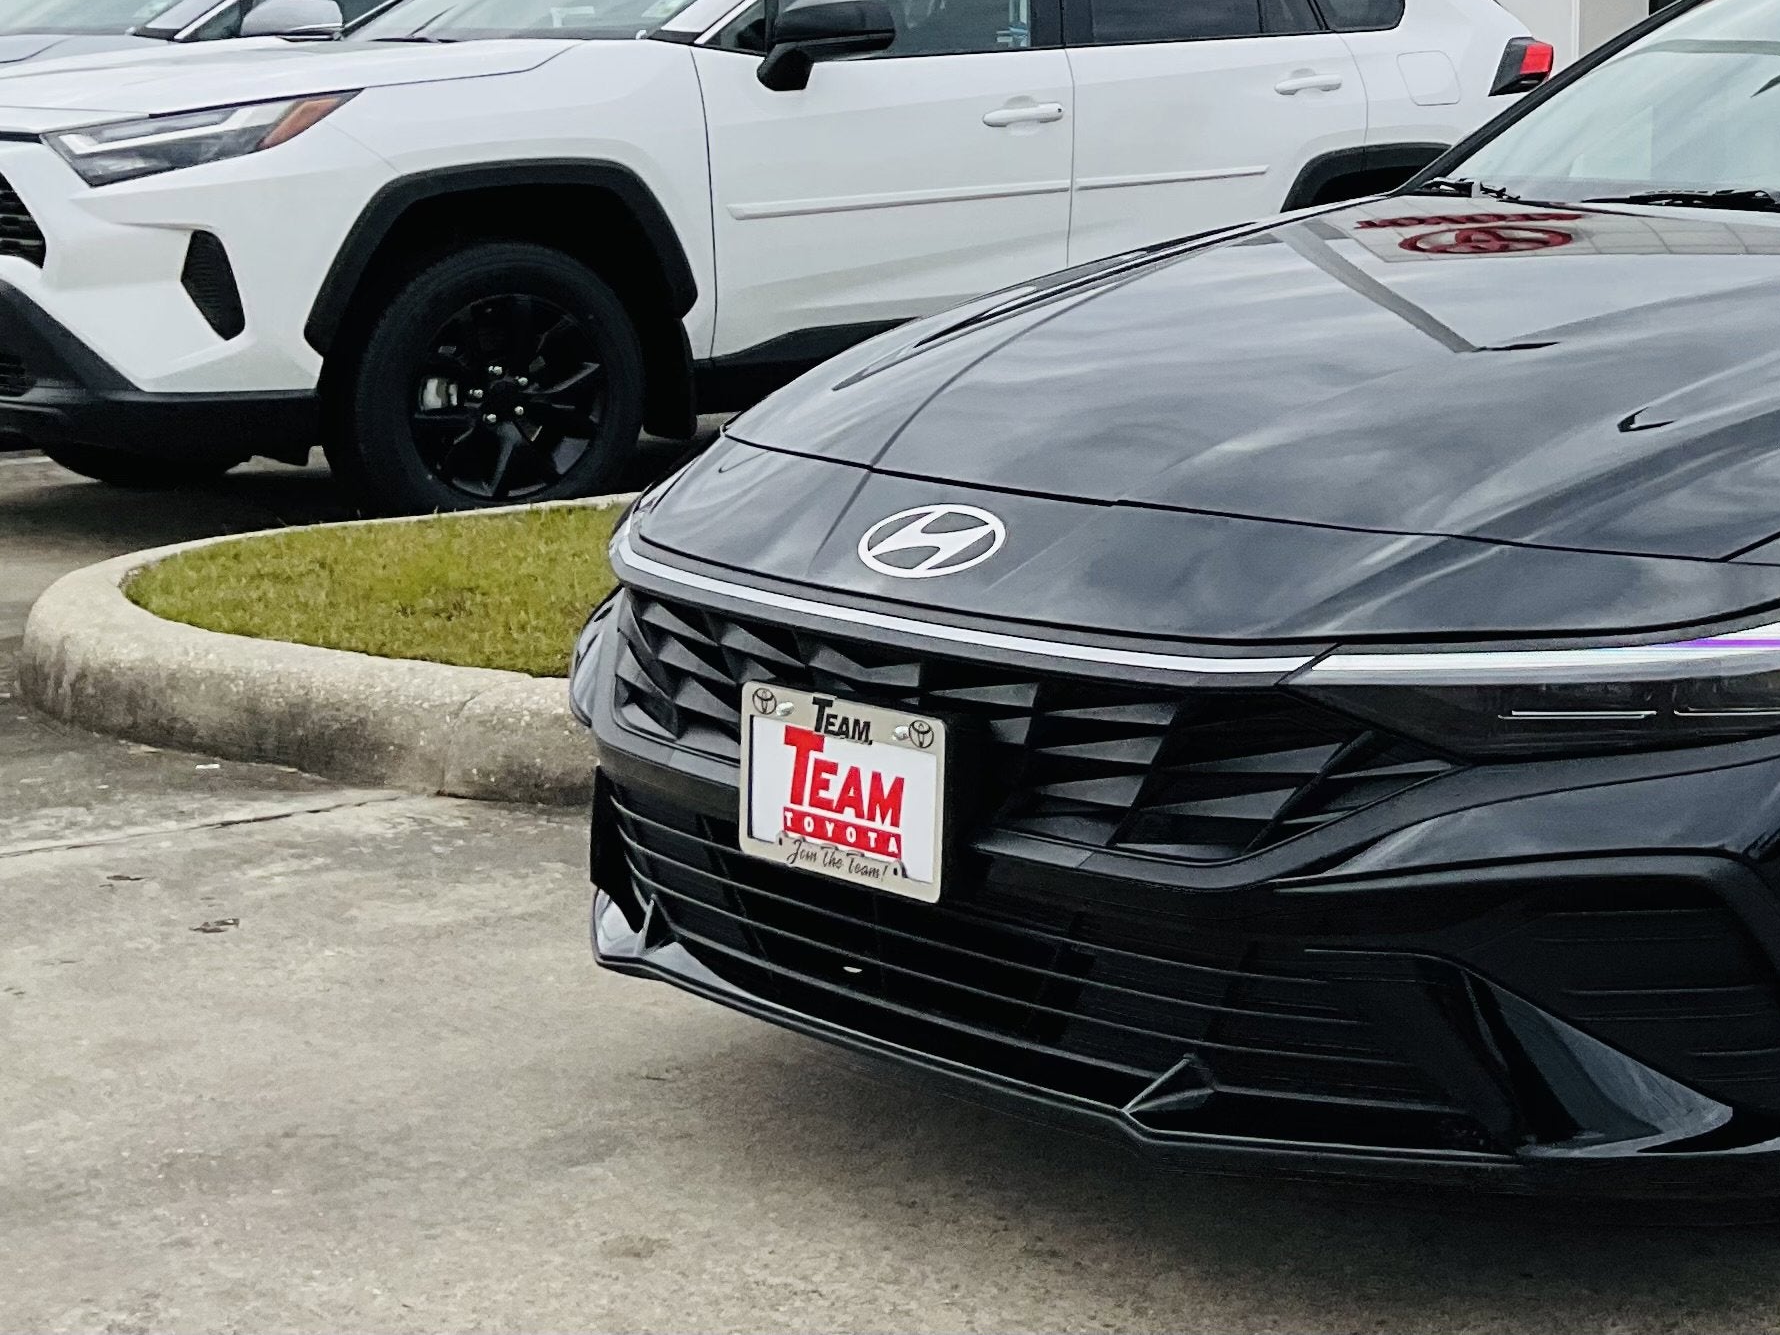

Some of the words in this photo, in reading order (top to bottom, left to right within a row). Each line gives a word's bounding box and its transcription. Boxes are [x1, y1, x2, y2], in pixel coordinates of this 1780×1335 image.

[784, 725, 905, 828] TEAM
[784, 811, 899, 854] TOYOTA
[786, 839, 817, 865] Join
